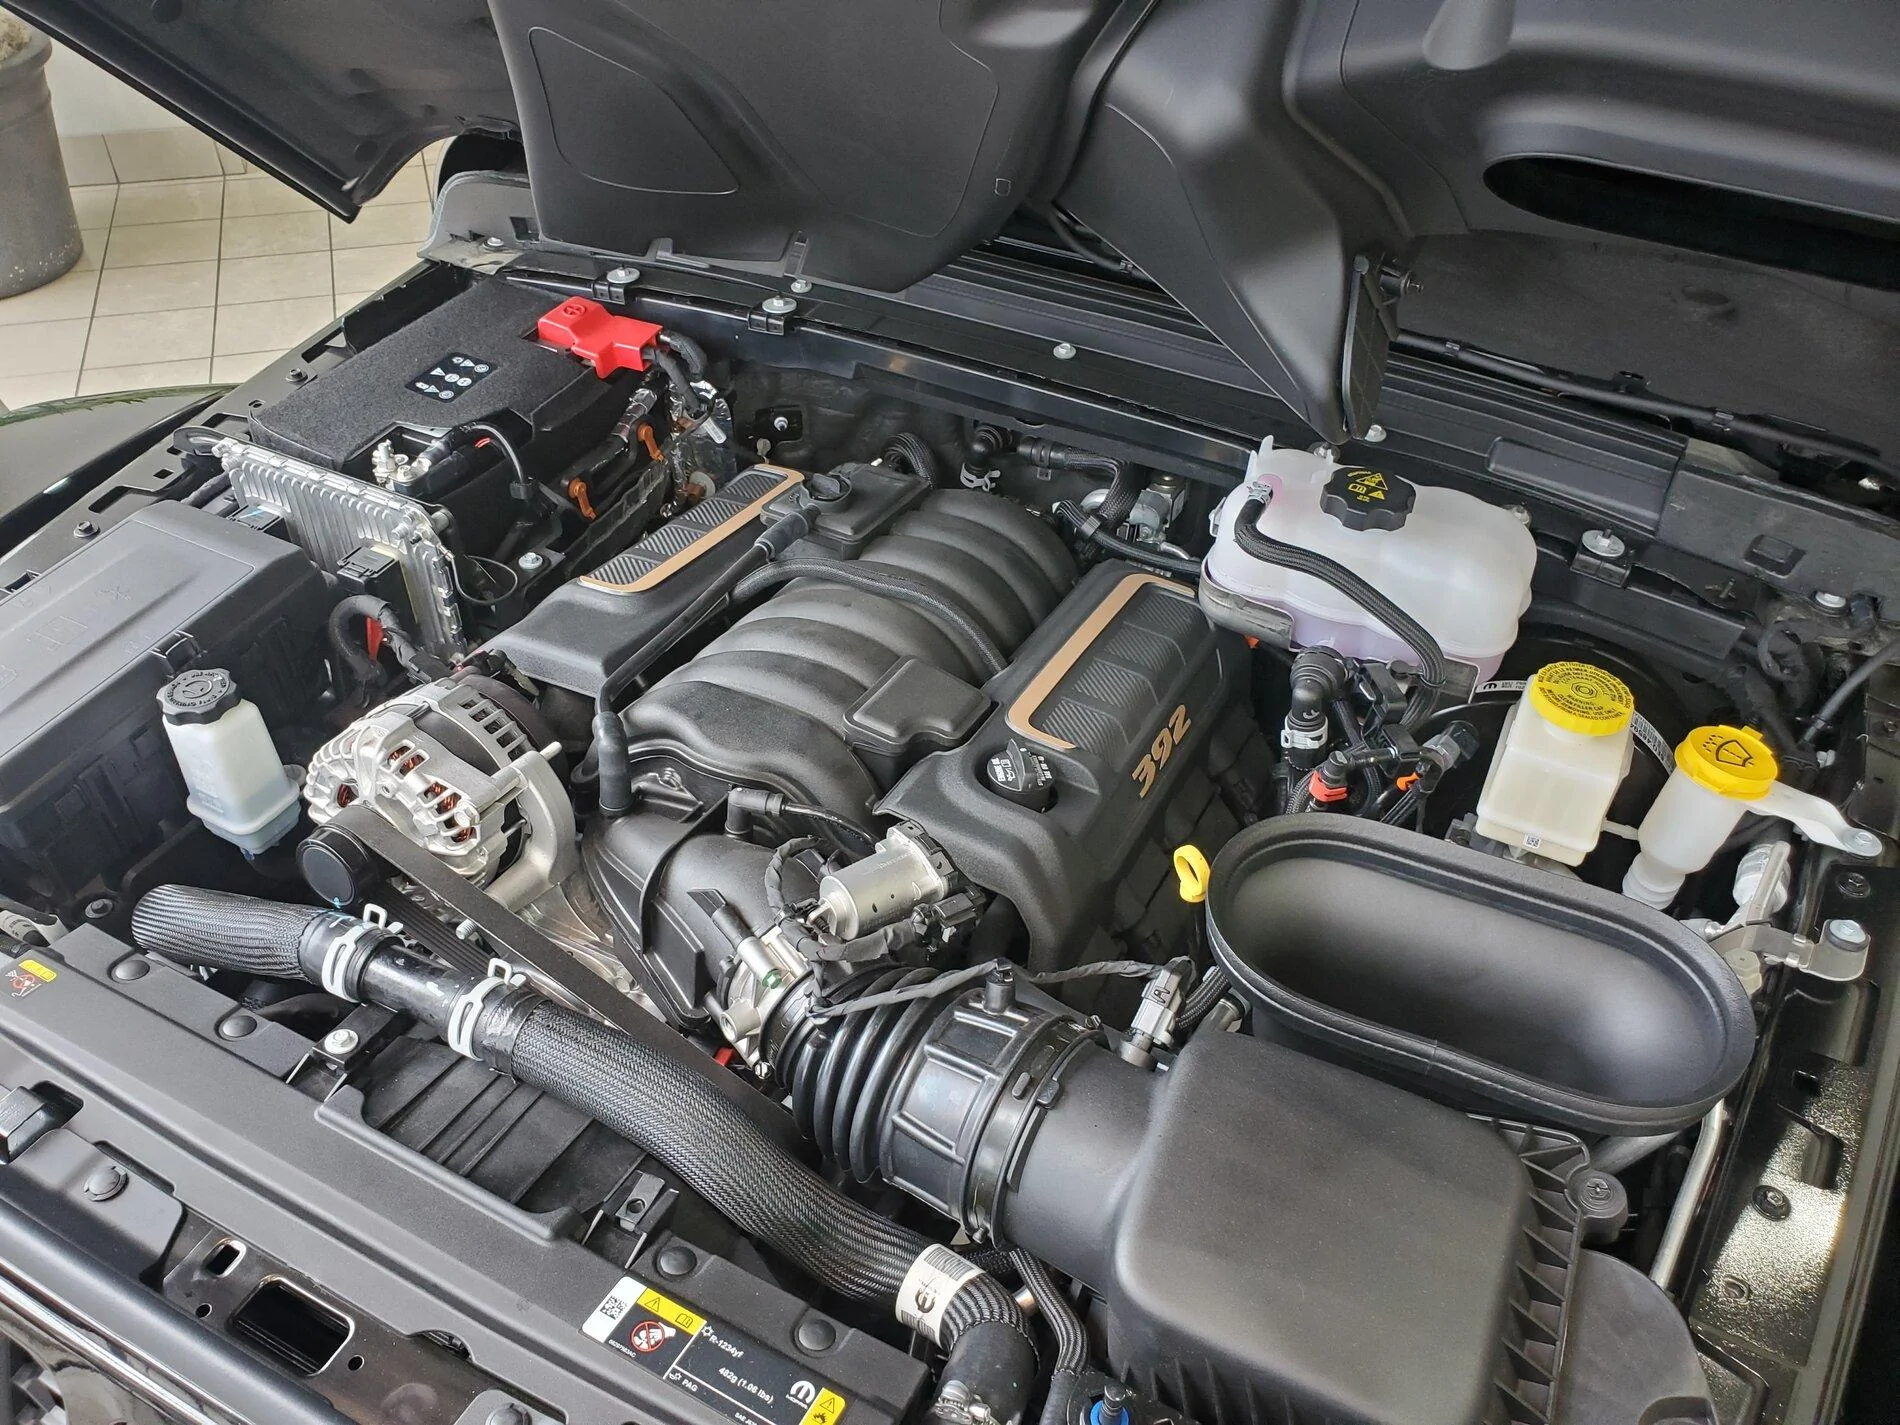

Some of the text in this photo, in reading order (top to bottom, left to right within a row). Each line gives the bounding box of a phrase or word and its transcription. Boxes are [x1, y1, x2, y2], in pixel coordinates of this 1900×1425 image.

[1132, 704, 1192, 798] 392
[709, 1335, 745, 1358] R-1234yf
[682, 1378, 698, 1392] PAG
[737, 1377, 757, 1395] (1.06
[757, 1386, 774, 1404] lbs)
